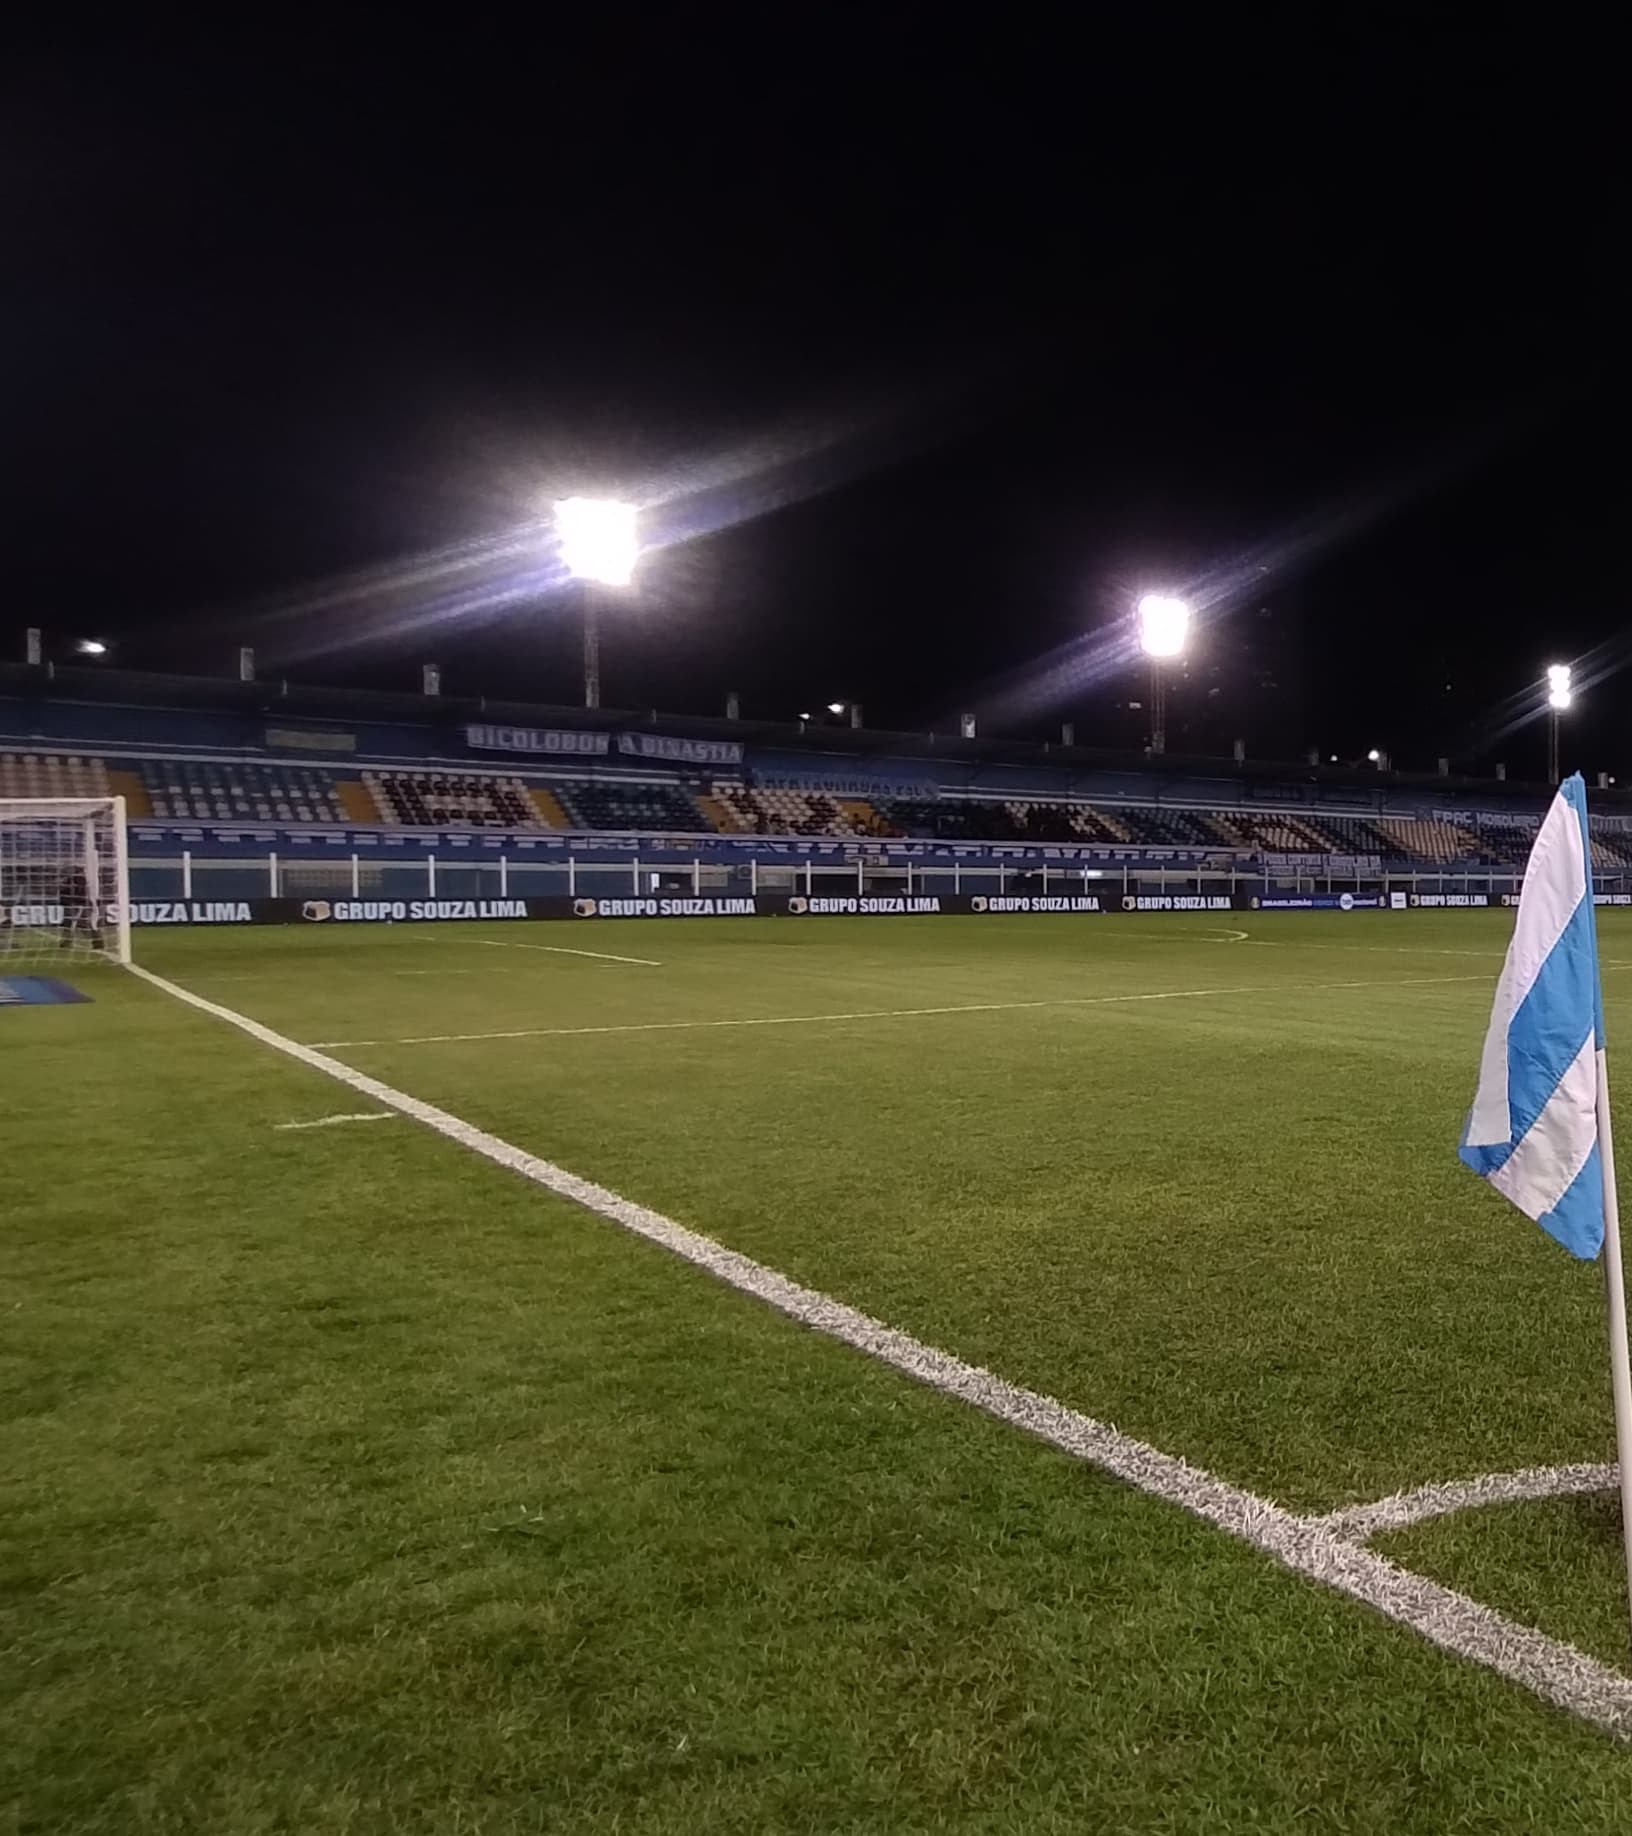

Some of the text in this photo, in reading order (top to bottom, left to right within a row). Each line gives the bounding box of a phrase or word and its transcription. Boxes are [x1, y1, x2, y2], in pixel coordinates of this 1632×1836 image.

[642, 736, 743, 762] DINASTIA
[600, 899, 756, 915] GRUPO SOUZA LIMA
[809, 898, 940, 913] GRUPO SOUZA LIMA
[989, 897, 1099, 911] GRUPO SOUZA LIMA
[1137, 896, 1232, 909] GRUPO SOUZA LIMA
[1421, 895, 1488, 906] GRUPO SOUZA LIMA
[192, 902, 252, 922] LIMA
[334, 900, 528, 919] GRUPO SOUZA LIMA
